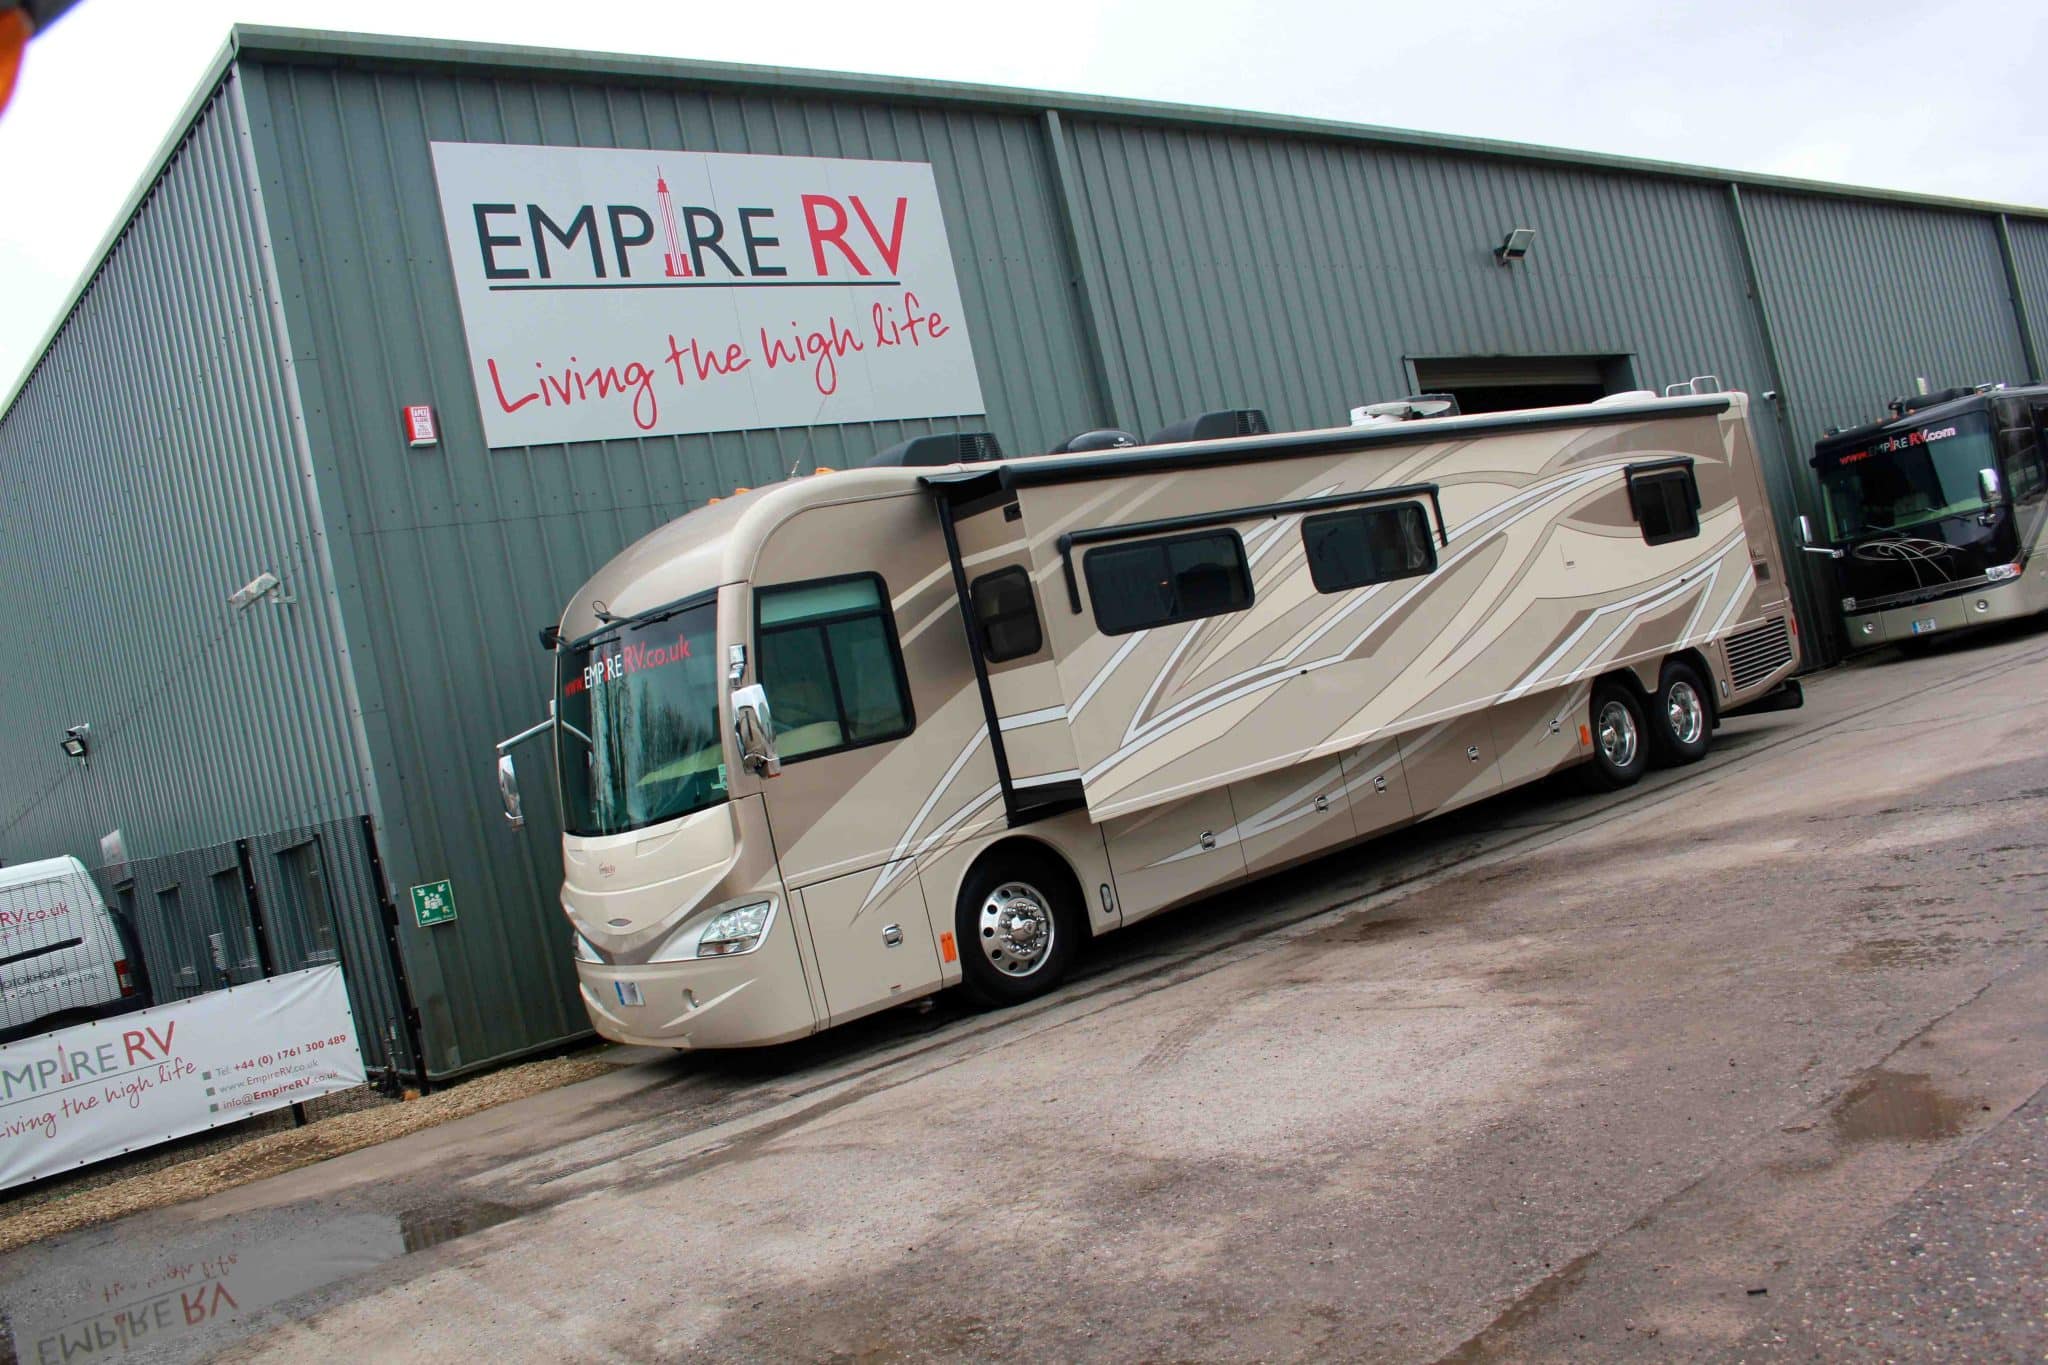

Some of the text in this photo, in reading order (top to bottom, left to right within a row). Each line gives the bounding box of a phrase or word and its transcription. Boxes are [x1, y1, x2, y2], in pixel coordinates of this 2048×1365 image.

[472, 165, 908, 279] EMPIRE RV
[487, 291, 949, 430] Living the high life
[0, 1020, 176, 1100] MPIRE RV
[60, 1098, 100, 1118] the
[104, 1075, 154, 1109] high
[158, 1056, 197, 1084] life
[233, 1059, 255, 1071] +44
[257, 1054, 274, 1068] (0)
[276, 1046, 302, 1061] 1761
[305, 1039, 325, 1053] 300
[327, 1034, 347, 1047] 489
